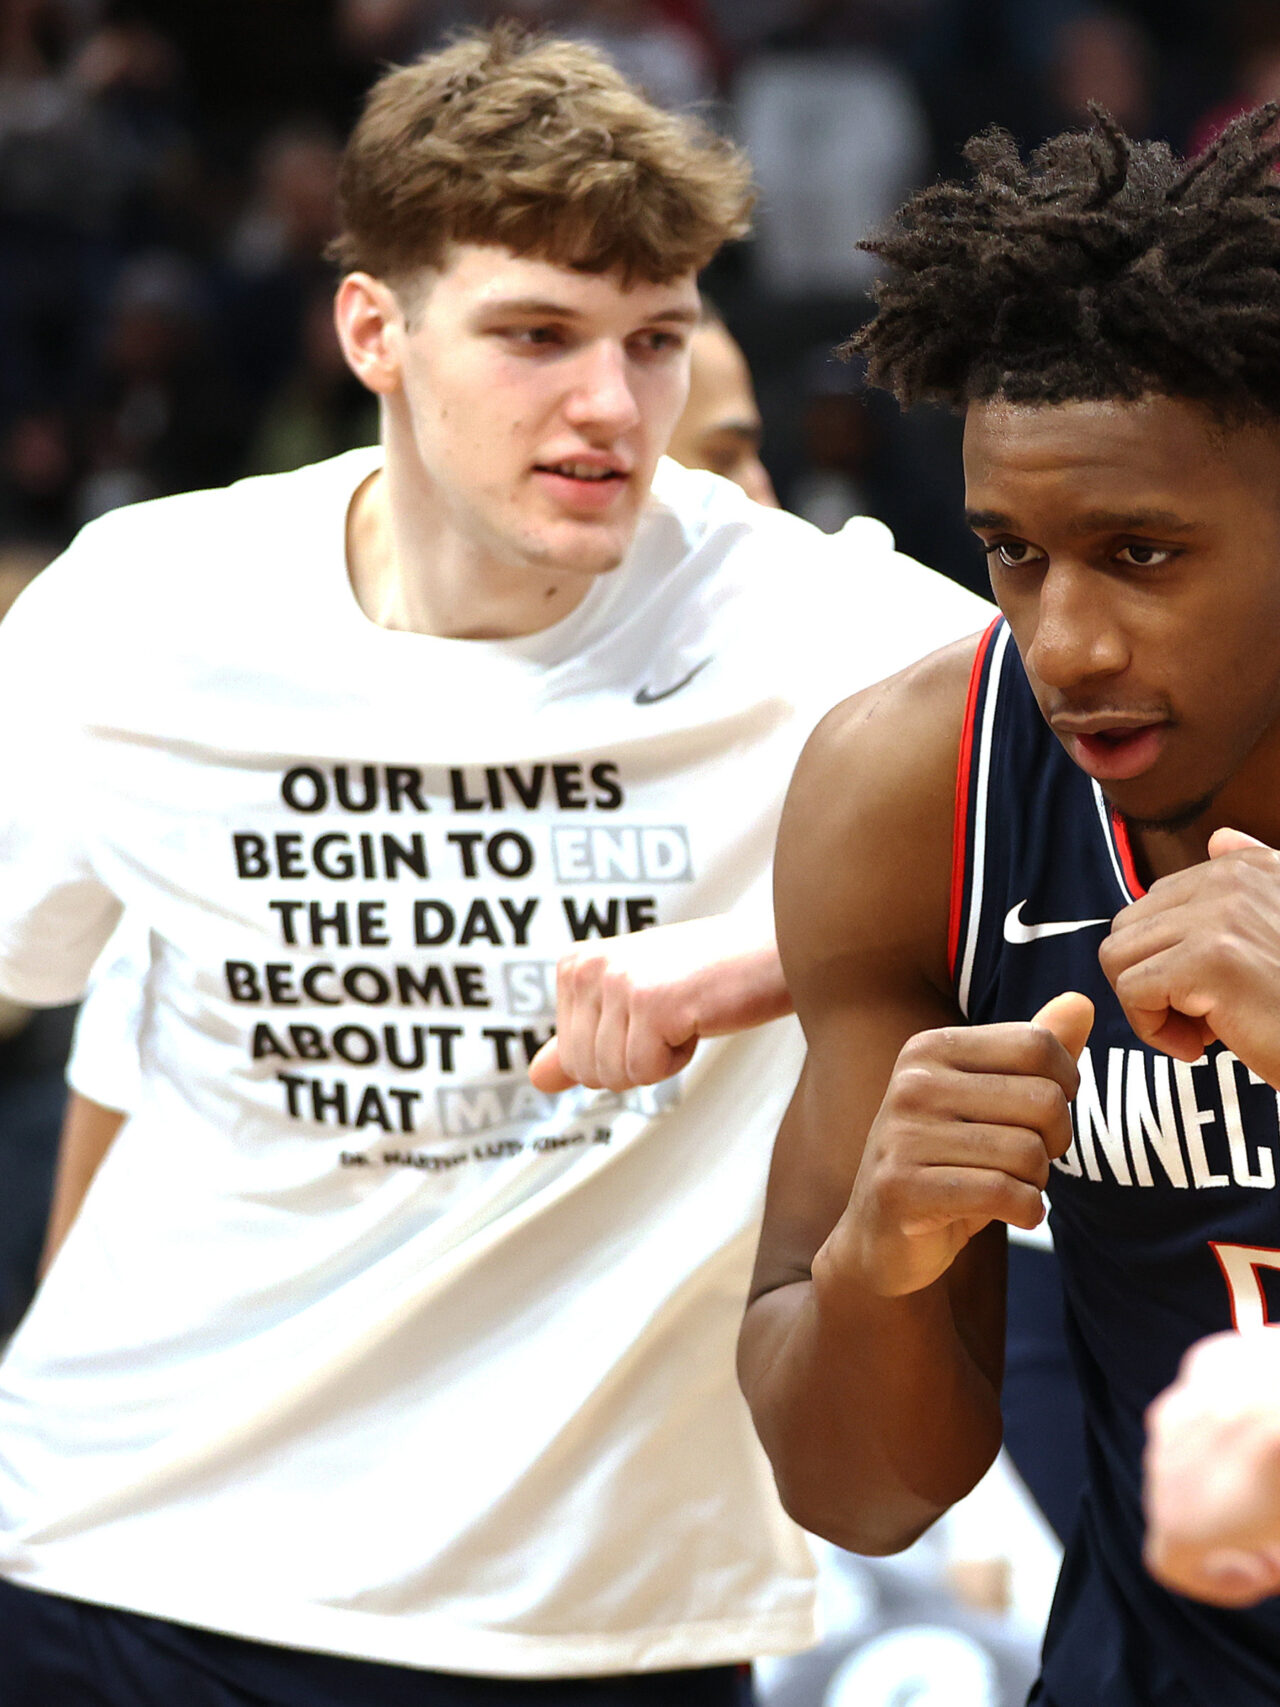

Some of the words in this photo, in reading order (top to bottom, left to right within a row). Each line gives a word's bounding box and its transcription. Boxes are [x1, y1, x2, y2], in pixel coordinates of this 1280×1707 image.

[280, 764, 431, 814] OUR
[447, 762, 625, 812] LIVES
[232, 831, 429, 881] BEGIN
[446, 830, 535, 881] TO
[554, 827, 689, 881] END
[268, 900, 391, 946] THE
[413, 897, 541, 947] DAY
[562, 897, 658, 942] WE
[224, 960, 492, 1009] BECOME
[251, 1022, 465, 1073] ABOUT
[276, 1072, 422, 1135] THAT
